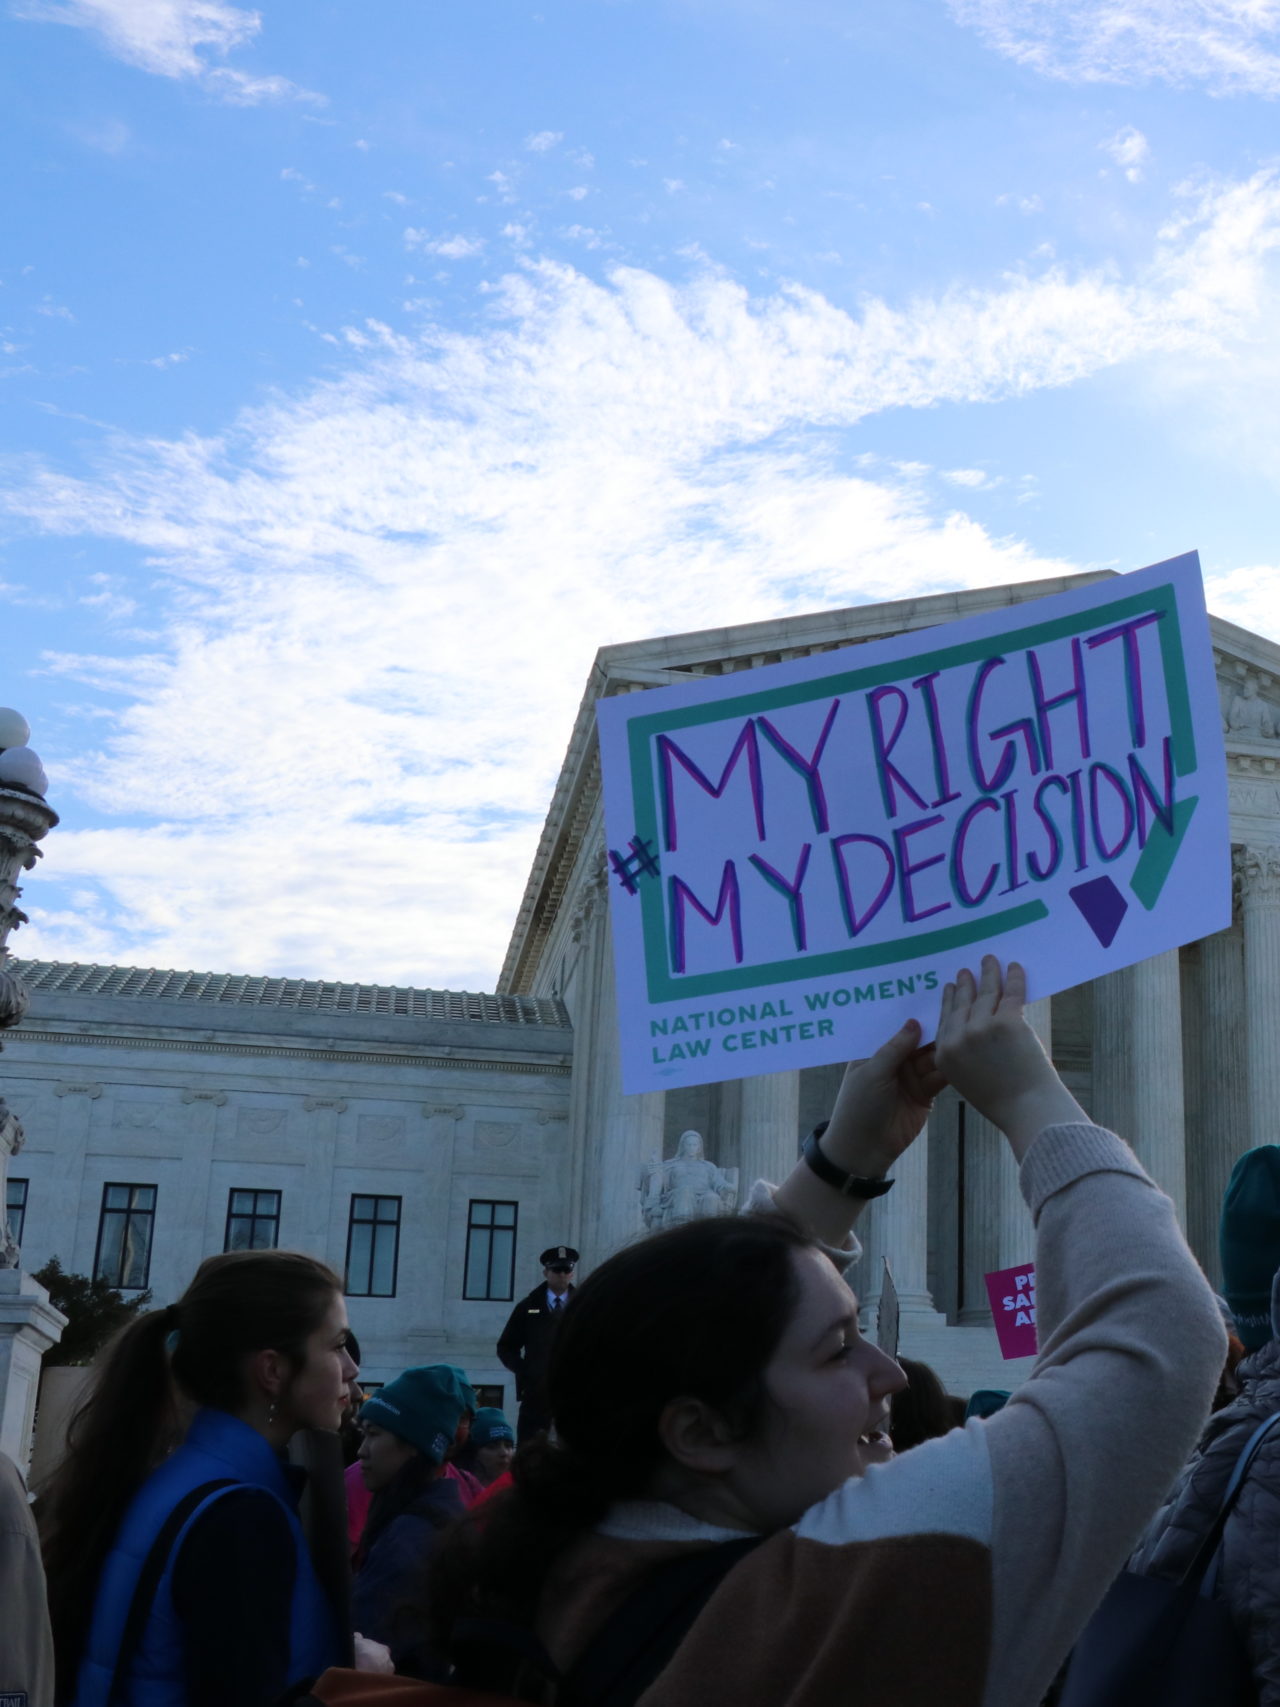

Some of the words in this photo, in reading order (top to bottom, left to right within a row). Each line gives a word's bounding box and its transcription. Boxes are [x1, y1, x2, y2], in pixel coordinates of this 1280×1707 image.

[655, 698, 841, 853] MY
[864, 609, 1168, 820] RIGHT
[608, 835, 661, 896] #
[667, 842, 811, 975] MY
[831, 736, 1177, 939] DECISION
[650, 999, 793, 1037] NATIONAL
[803, 970, 939, 1012] WOMEN'S
[652, 1038, 712, 1064] LAW
[722, 1018, 835, 1053] CENTER
